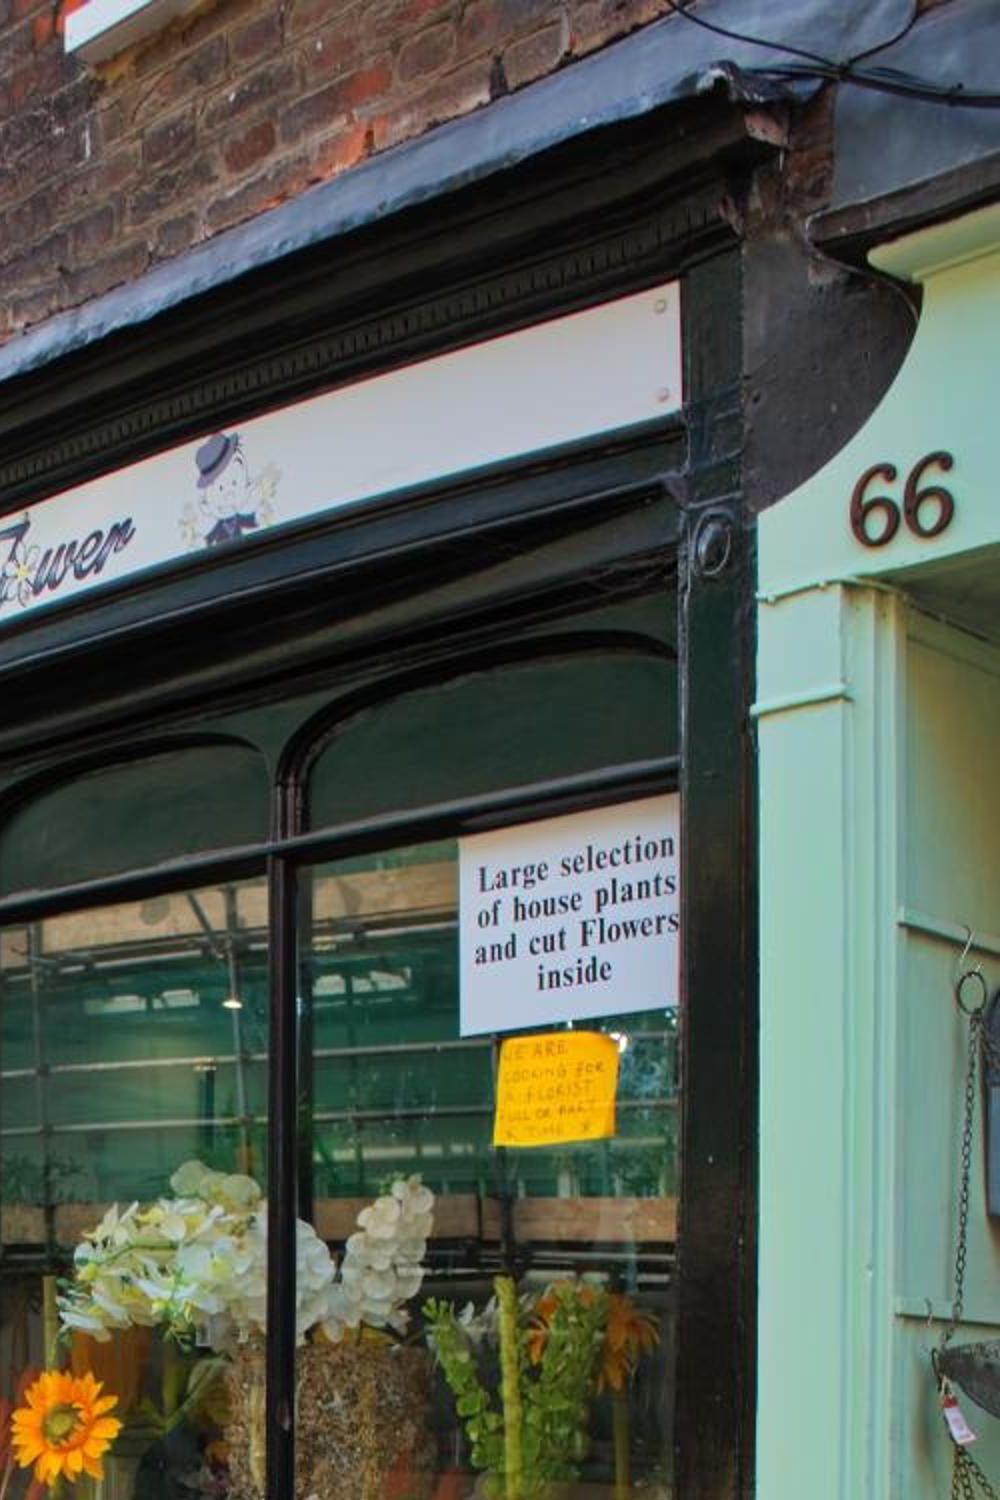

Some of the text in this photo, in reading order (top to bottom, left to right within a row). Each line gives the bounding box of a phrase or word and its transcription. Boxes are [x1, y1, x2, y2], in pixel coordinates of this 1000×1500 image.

[850, 451, 954, 547] 66
[479, 836, 675, 893] Large selection
[477, 873, 676, 929] of house plants
[475, 912, 680, 965] and cut Flowers
[537, 956, 612, 991] inside
